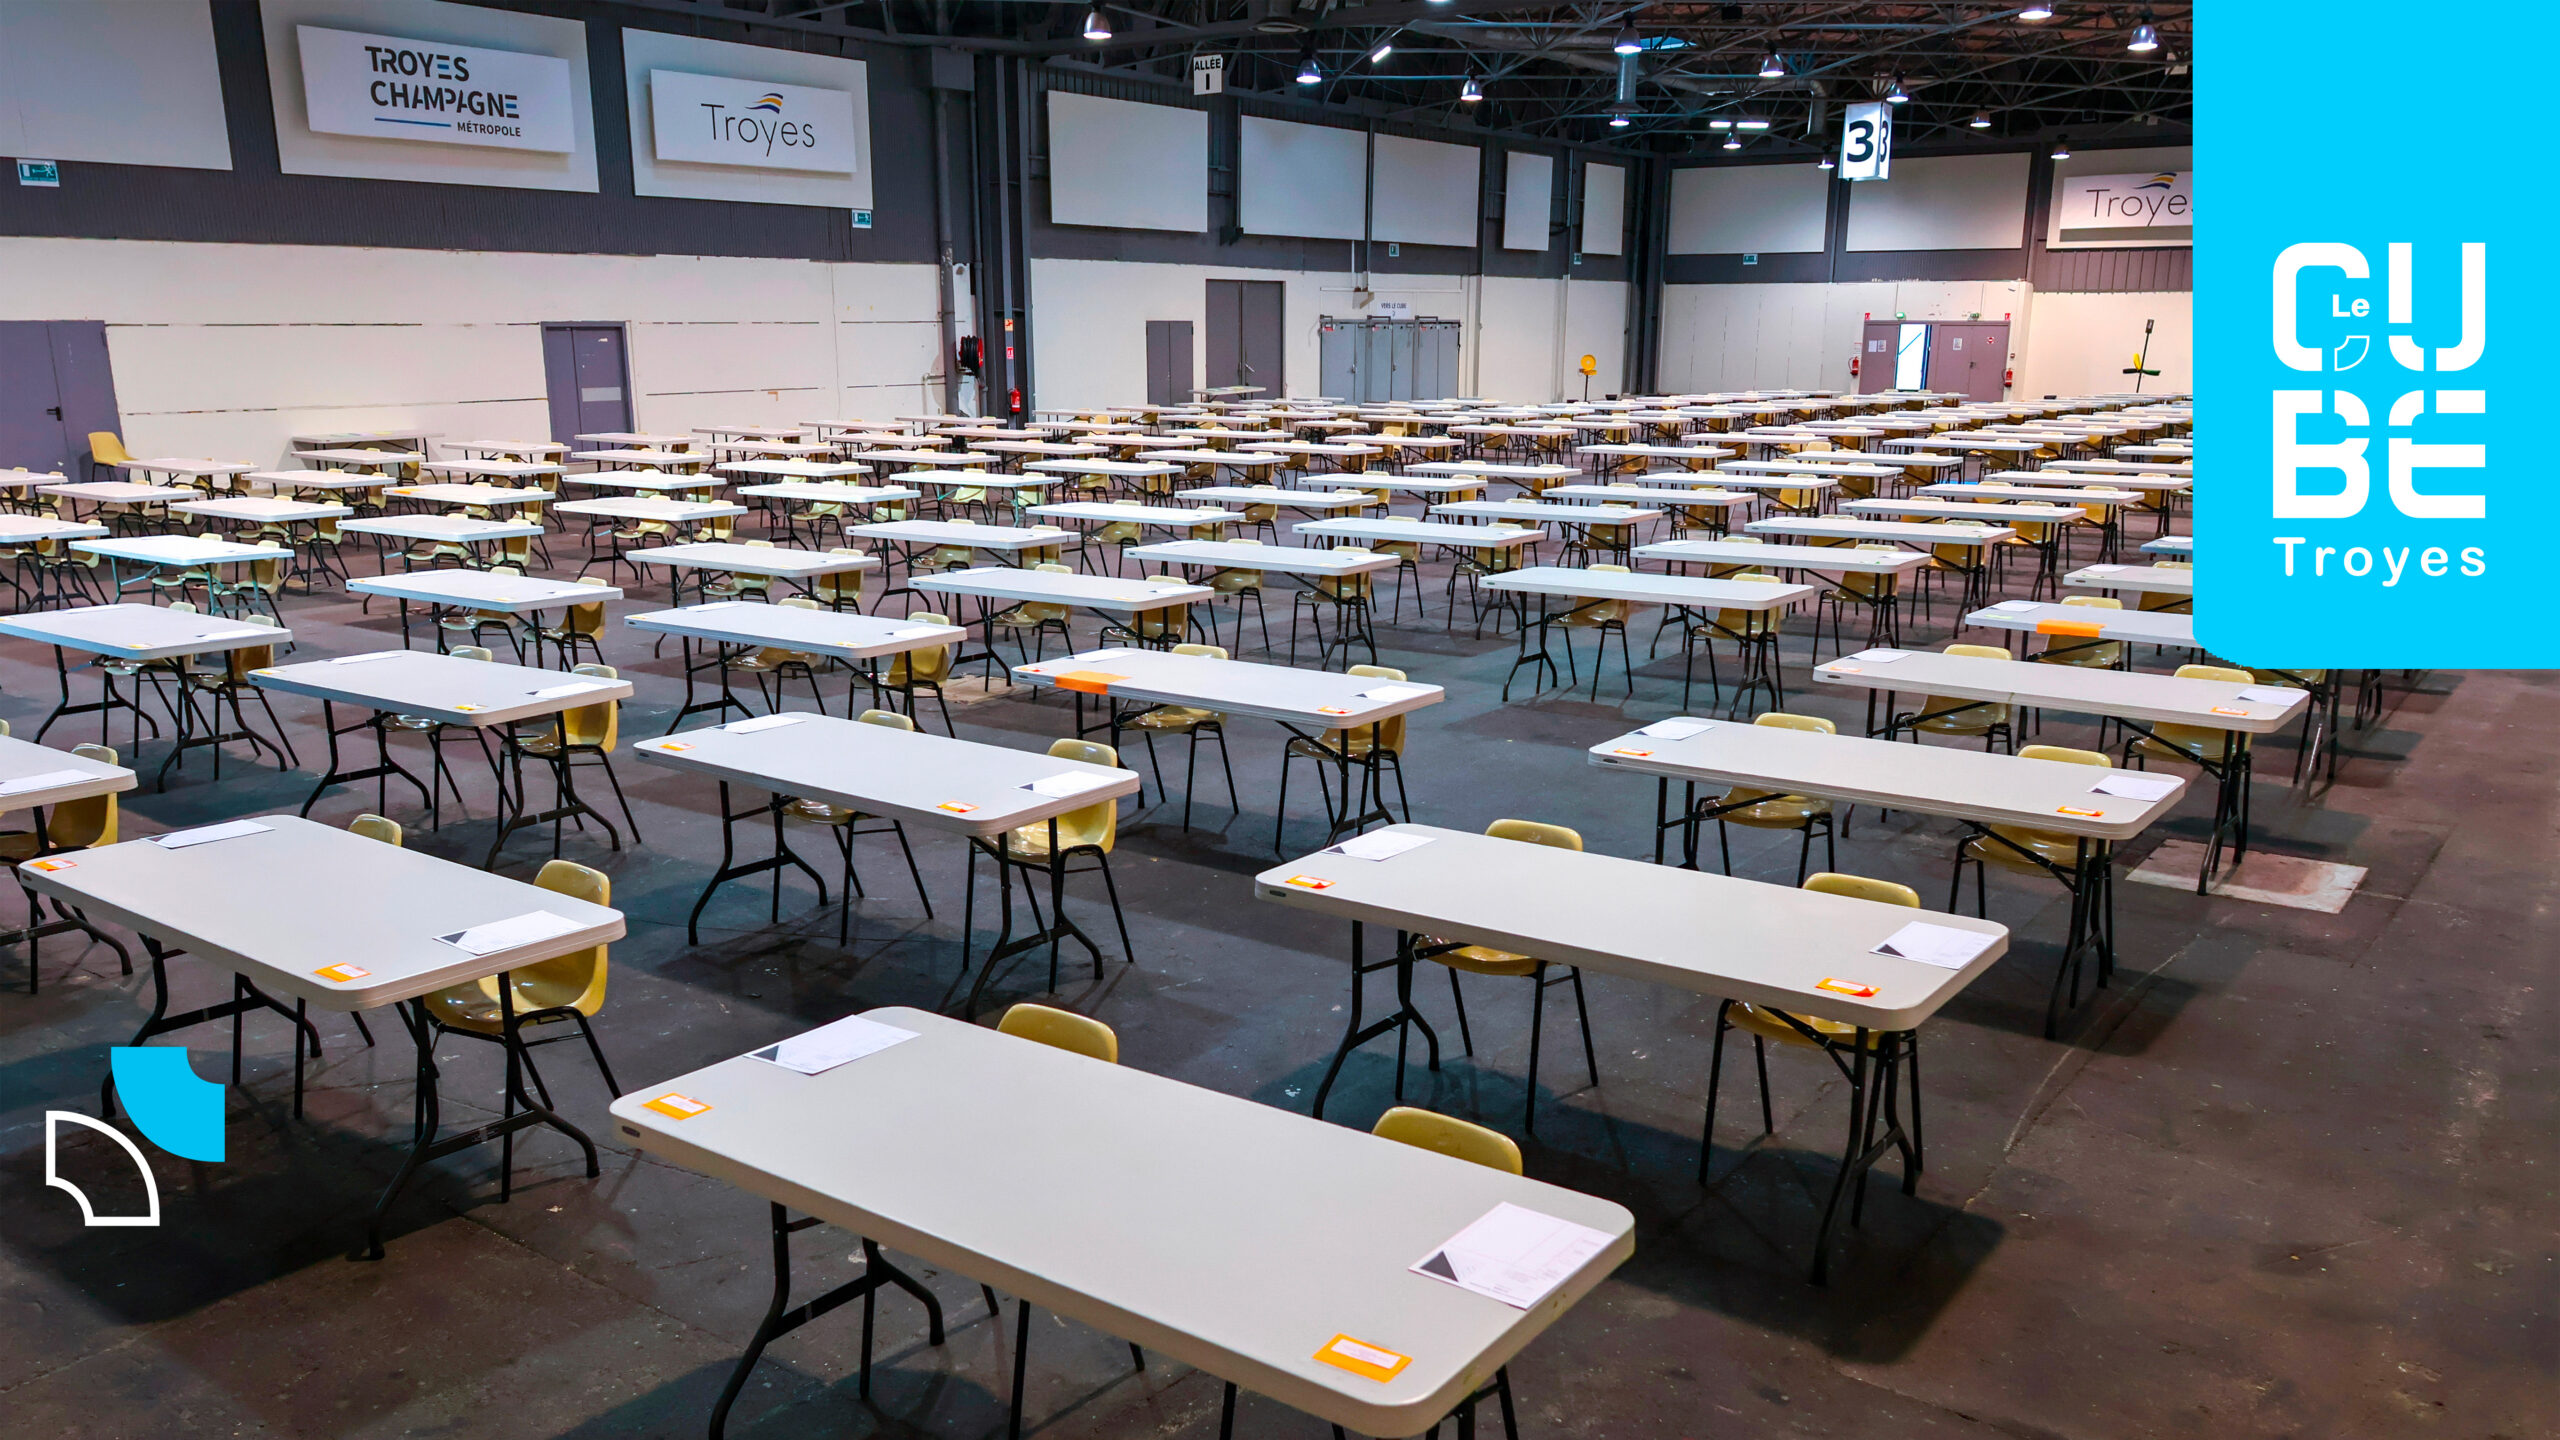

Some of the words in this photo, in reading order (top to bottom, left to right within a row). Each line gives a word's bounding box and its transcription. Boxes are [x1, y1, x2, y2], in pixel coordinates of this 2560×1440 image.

[364, 45, 470, 83] TROYES
[1194, 56, 1221, 71] ALLÉE
[370, 80, 520, 120] CHAMPAGNE
[457, 120, 521, 137] MÉTROPOLE
[701, 102, 815, 158] Troyes
[1847, 120, 1874, 163] 3
[2085, 188, 2193, 227] Troye
